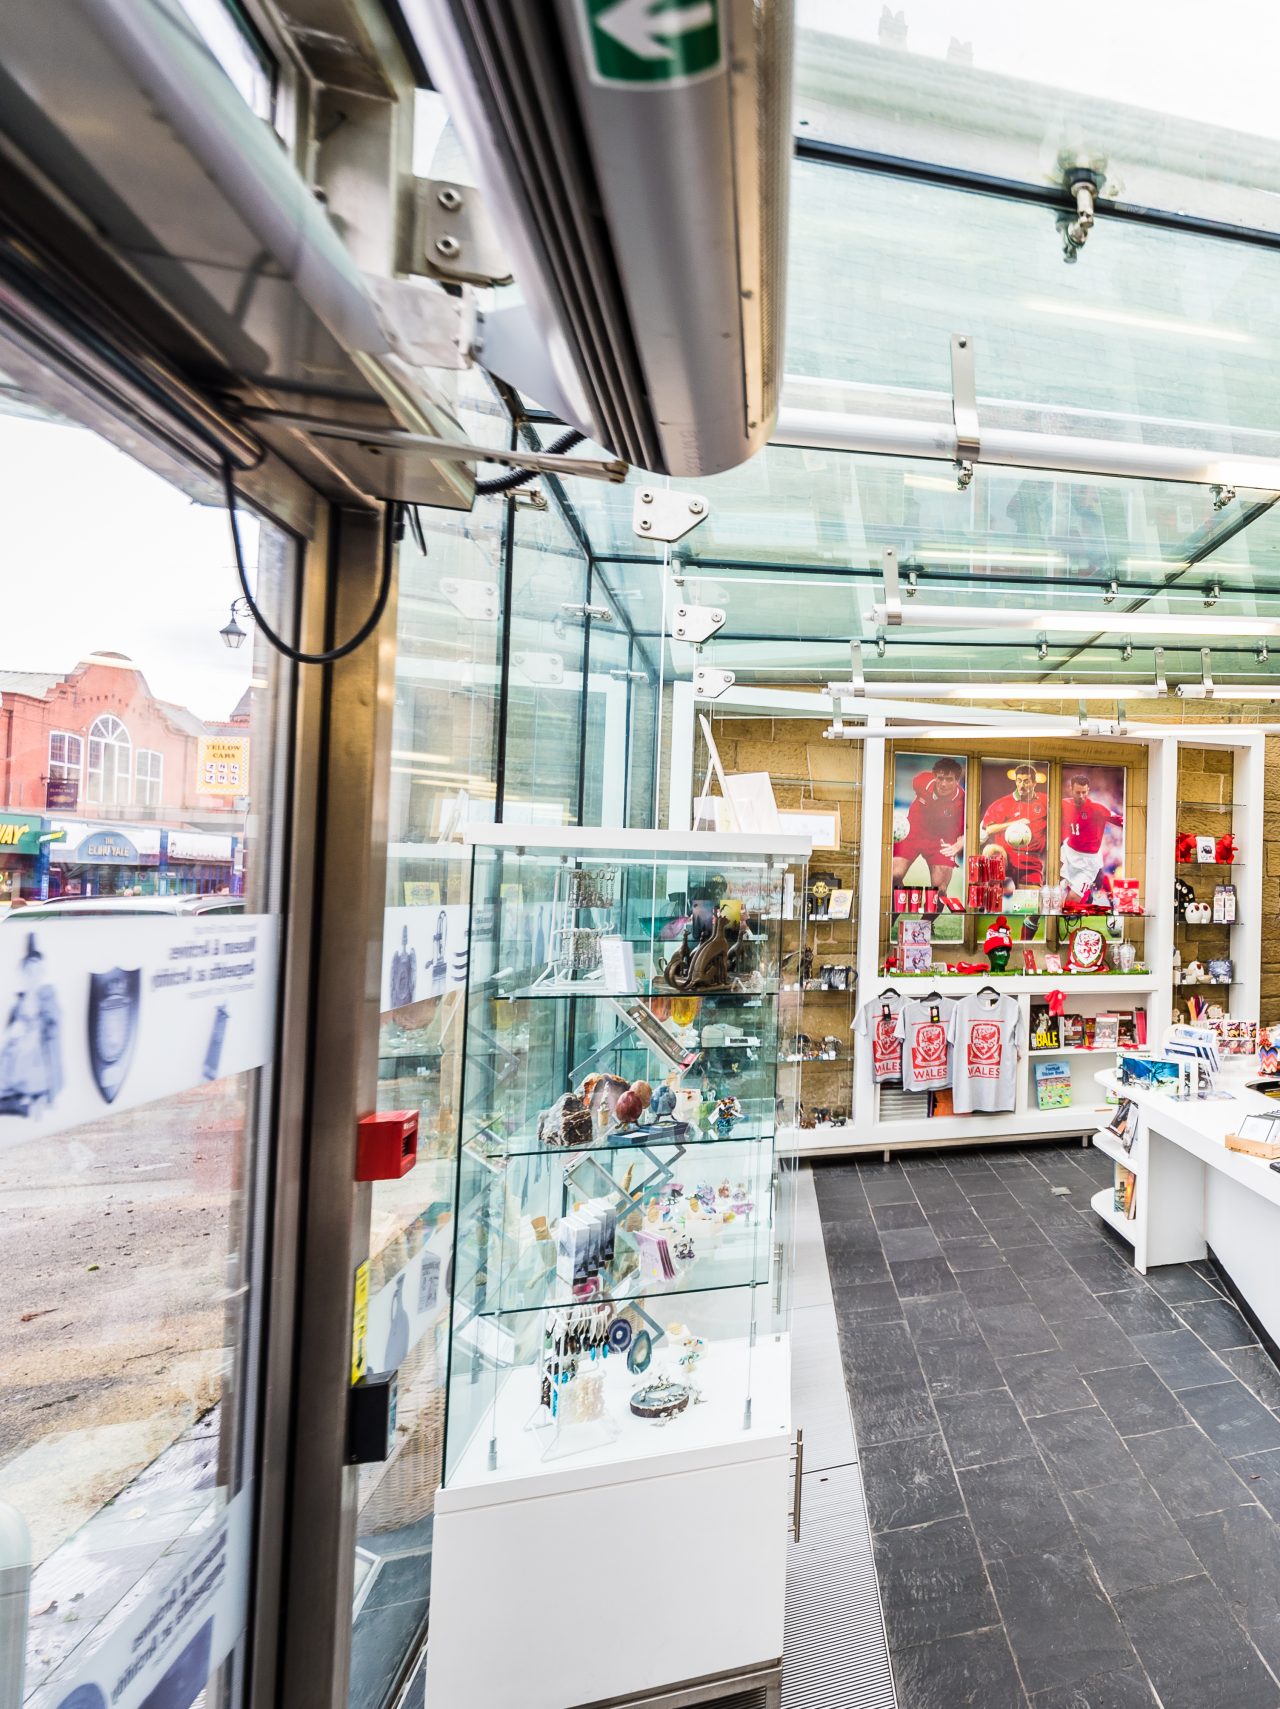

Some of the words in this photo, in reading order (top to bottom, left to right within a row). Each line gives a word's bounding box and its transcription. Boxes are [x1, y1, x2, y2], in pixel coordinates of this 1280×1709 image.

[1036, 1031, 1059, 1047] BALE
[913, 1067, 948, 1079] WALES
[967, 1066, 1000, 1077] WALES
